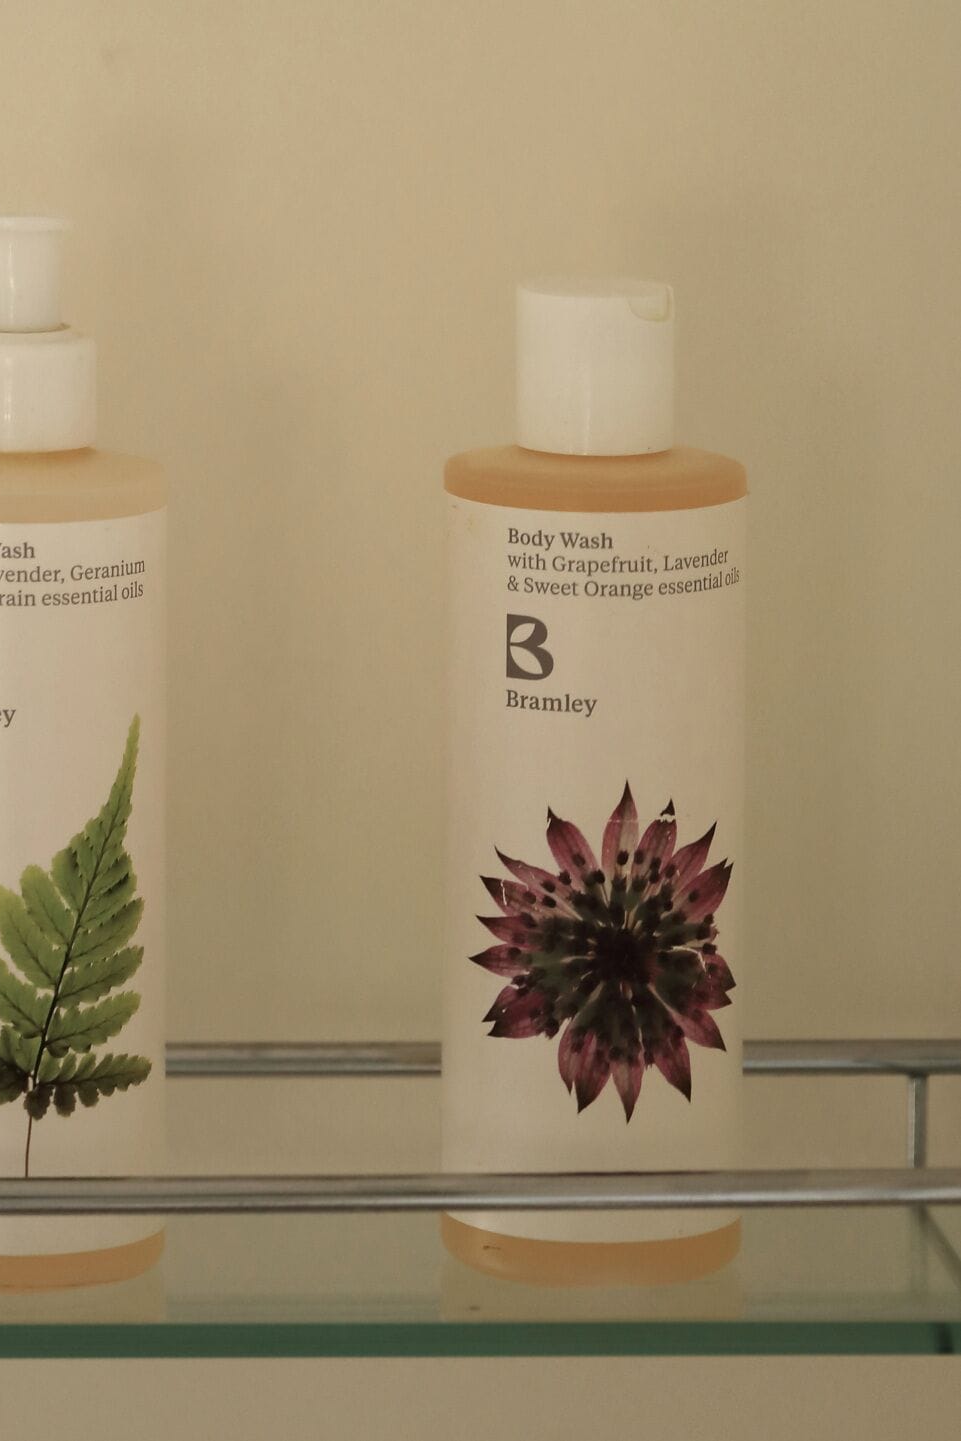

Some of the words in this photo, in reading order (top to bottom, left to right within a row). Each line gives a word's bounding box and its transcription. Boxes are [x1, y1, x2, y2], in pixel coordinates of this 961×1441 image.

[508, 528, 555, 551] Body
[560, 532, 613, 549] Wash
[70, 560, 145, 581] Geranium
[508, 553, 546, 570] with
[552, 556, 657, 576] Grapefruit,
[663, 548, 728, 571] Lavender
[42, 585, 117, 606] essential
[122, 581, 143, 600] oils
[507, 576, 519, 592] &
[524, 578, 578, 596] Sweet
[584, 581, 653, 600] Orange
[658, 572, 722, 595] essential
[725, 567, 740, 585] oils
[506, 689, 598, 717] Bramley
